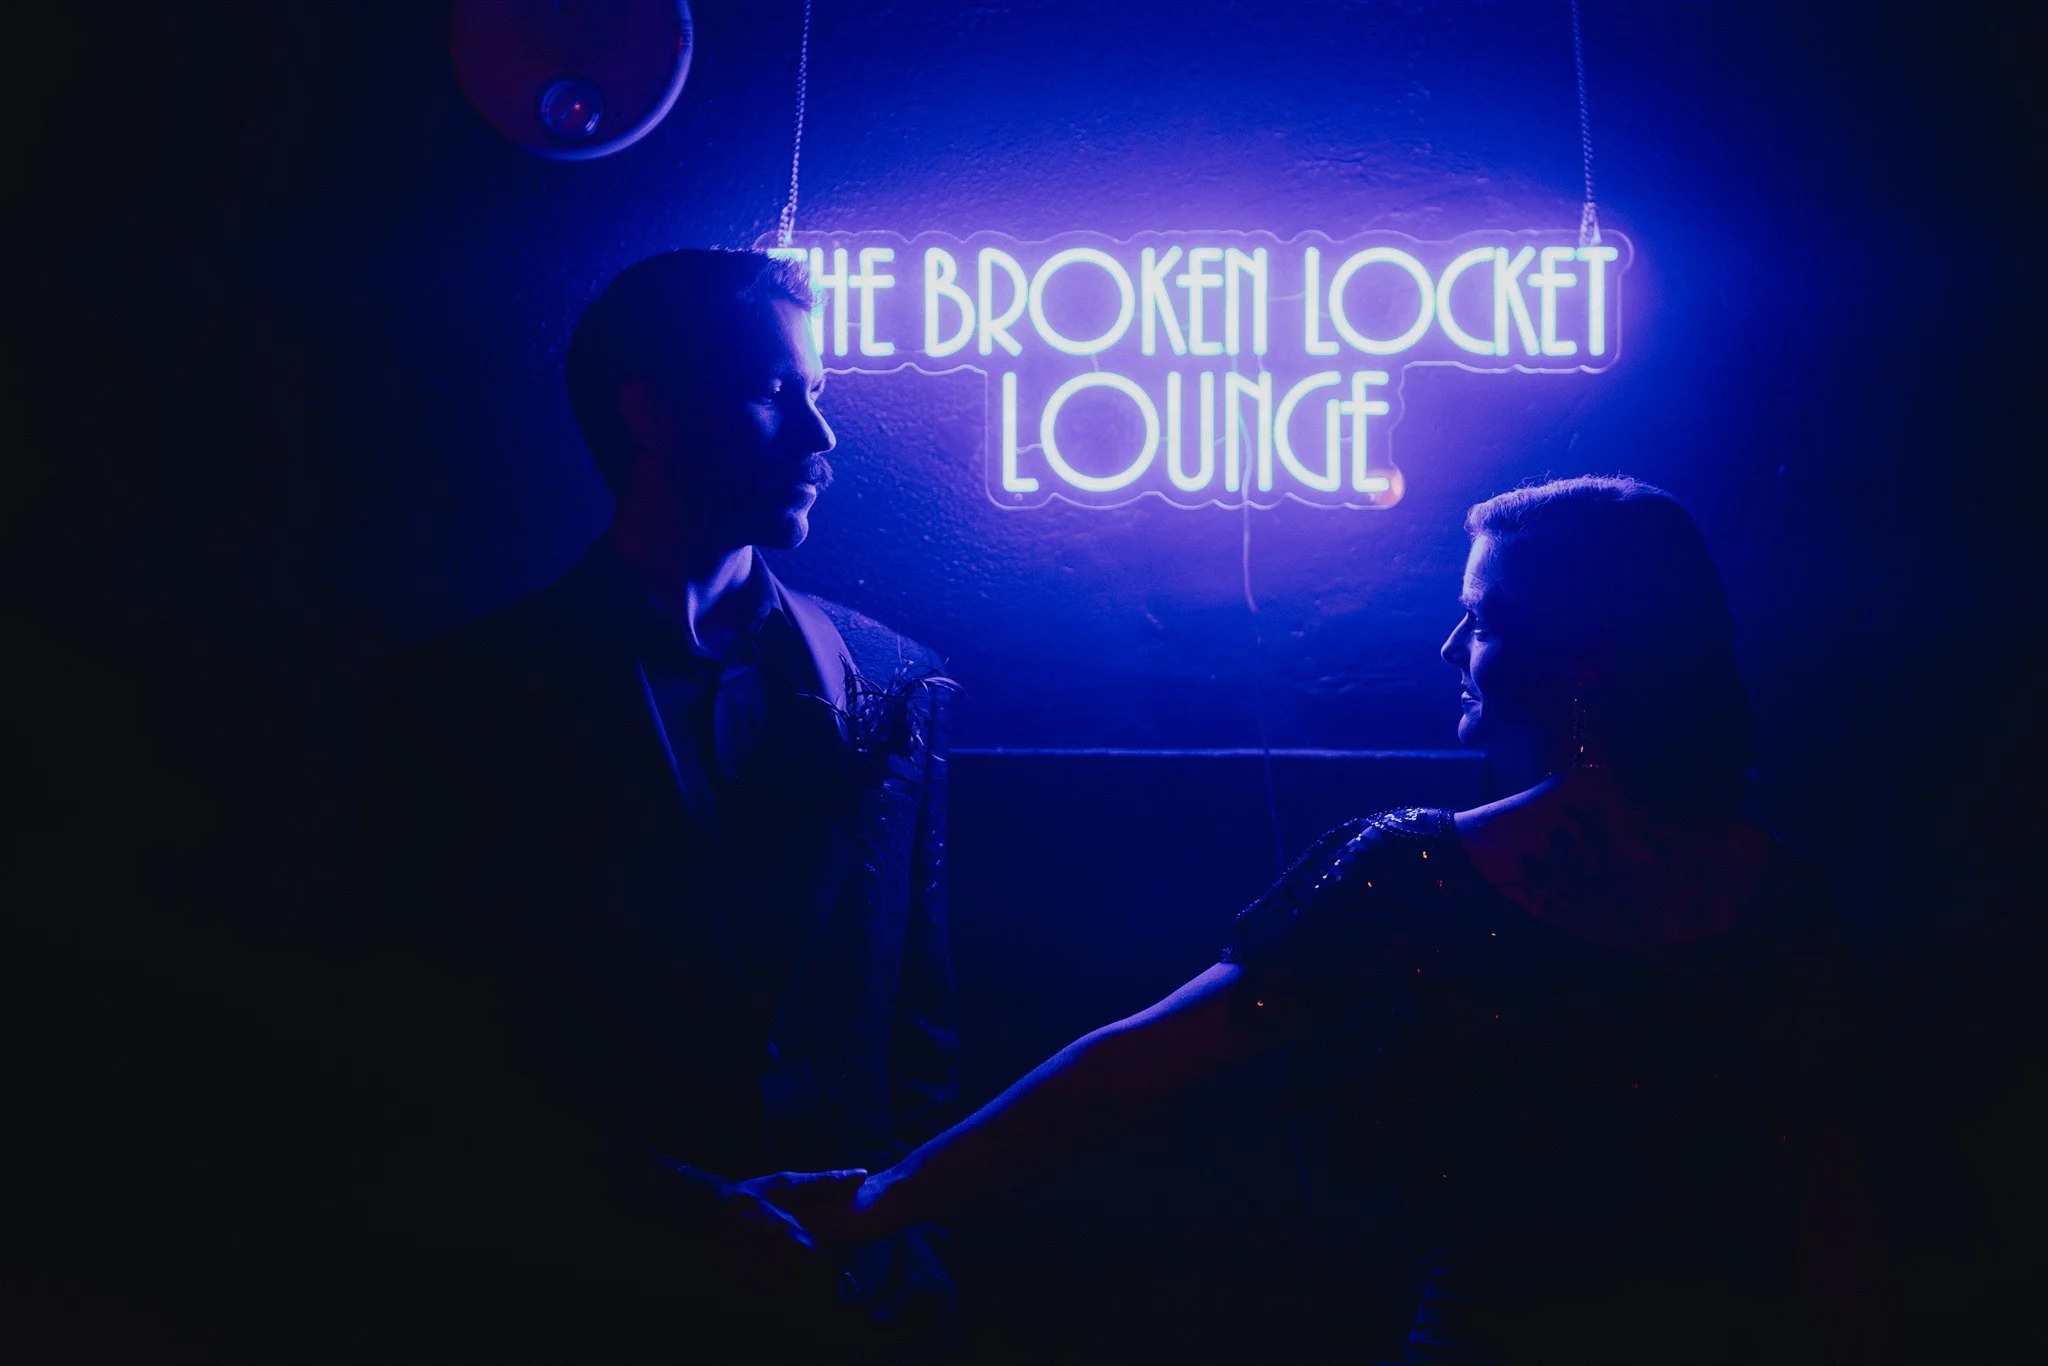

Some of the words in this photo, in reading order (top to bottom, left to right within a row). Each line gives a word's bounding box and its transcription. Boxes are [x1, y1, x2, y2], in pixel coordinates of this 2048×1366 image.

[924, 246, 1268, 357] BROKEN
[1304, 245, 1619, 356] LOCKET
[1002, 370, 1390, 493] LOUNGE
